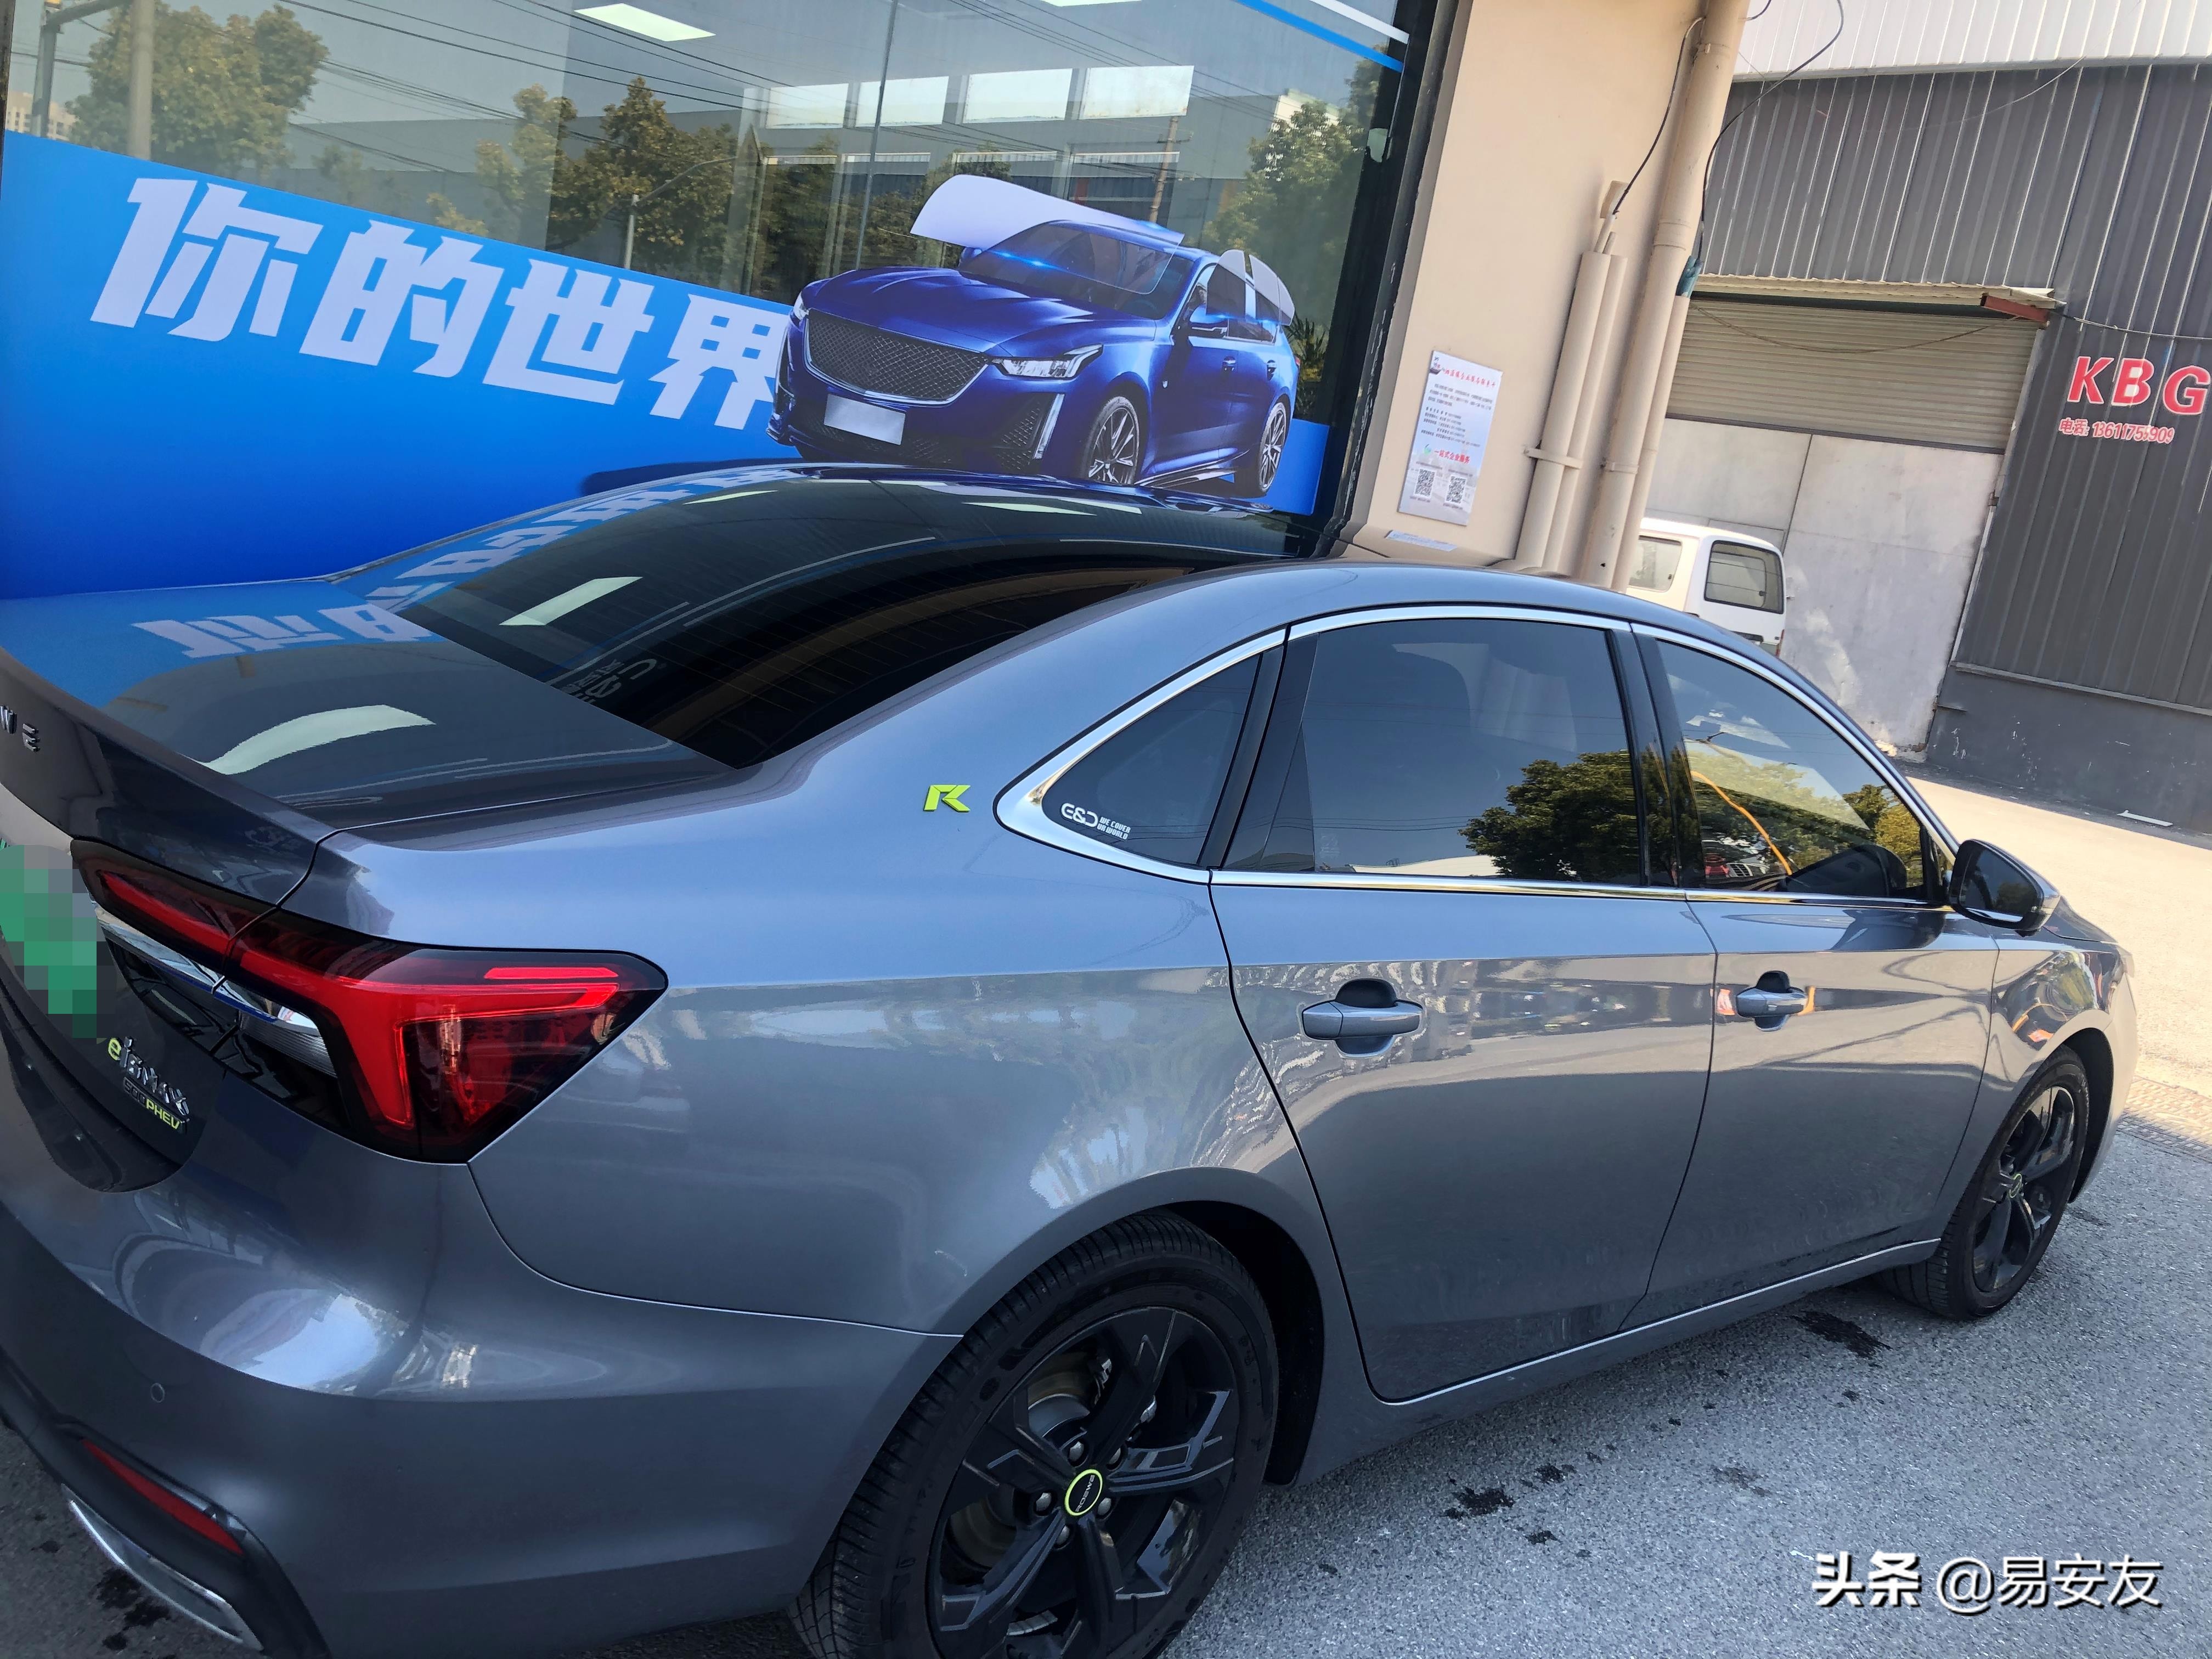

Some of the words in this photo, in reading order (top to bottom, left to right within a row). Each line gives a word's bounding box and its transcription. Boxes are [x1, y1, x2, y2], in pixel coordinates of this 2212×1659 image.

[91, 177, 792, 430] 你的世界
[2067, 356, 2211, 415] KBG
